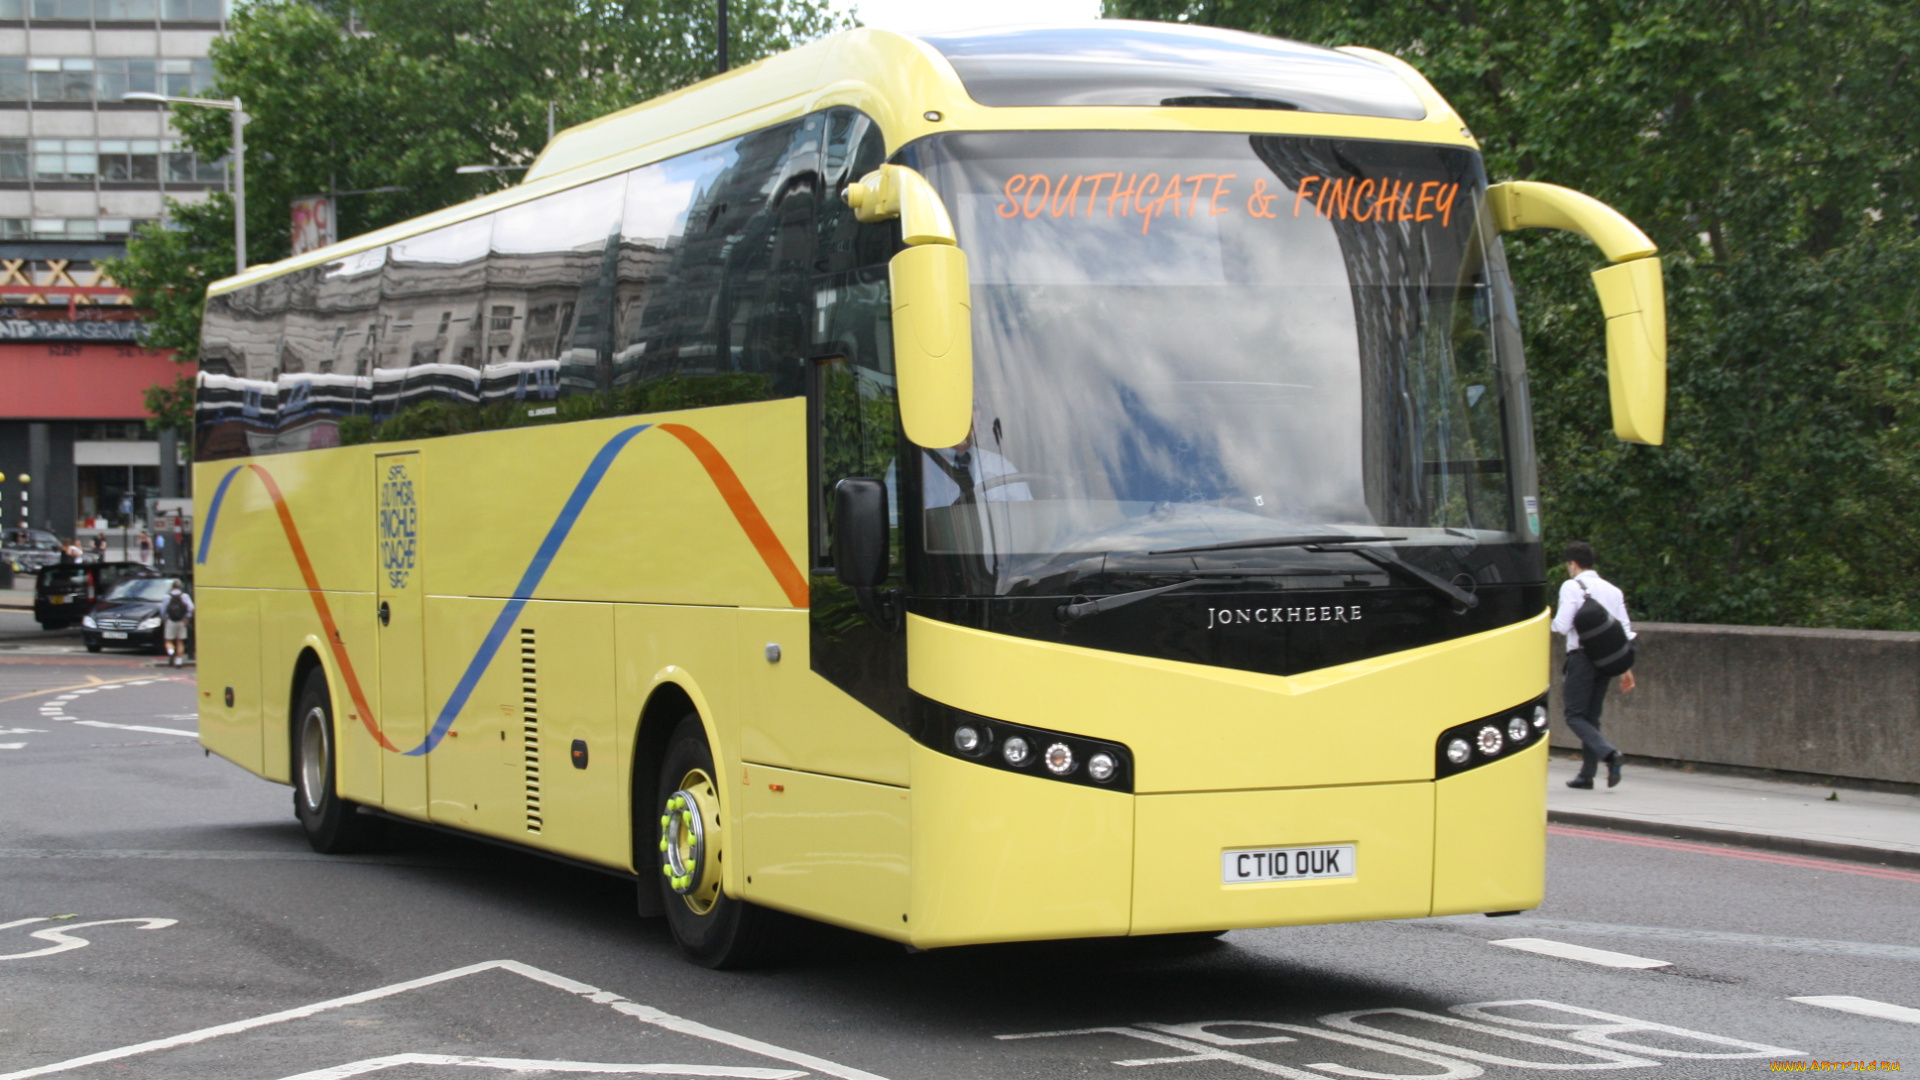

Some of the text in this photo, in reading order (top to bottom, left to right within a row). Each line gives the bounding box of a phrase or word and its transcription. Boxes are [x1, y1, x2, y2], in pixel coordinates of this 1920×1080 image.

[997, 172, 1459, 234] SOUTHGATE & FINCHLEY
[1207, 605, 1363, 629] JONCKHEERE
[1237, 852, 1288, 878] CT10
